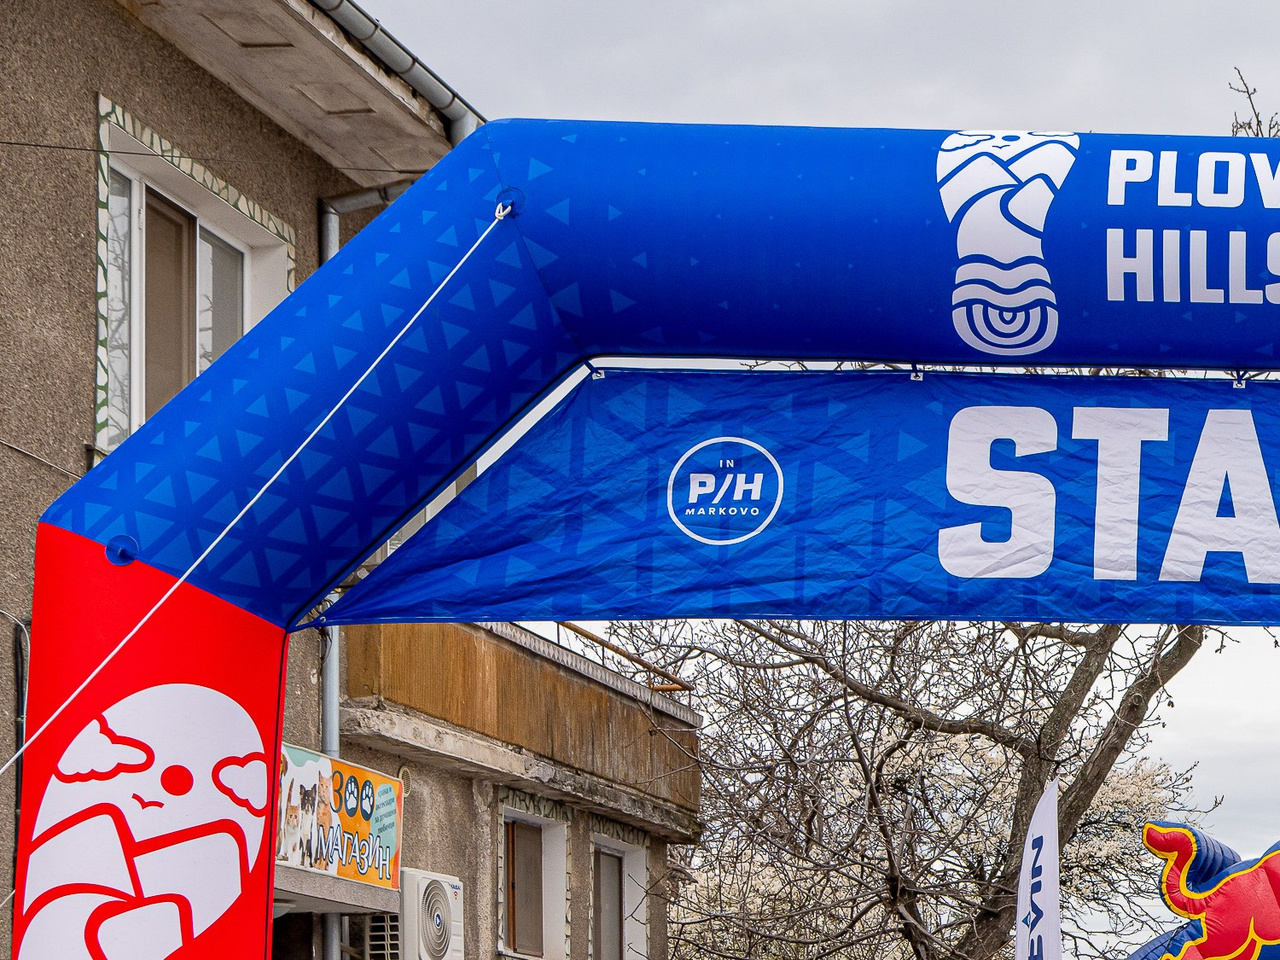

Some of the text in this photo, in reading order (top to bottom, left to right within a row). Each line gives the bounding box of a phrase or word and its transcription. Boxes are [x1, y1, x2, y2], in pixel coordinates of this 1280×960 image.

[719, 459, 735, 469] IN
[688, 473, 764, 504] P/H
[685, 507, 760, 516] MARKOVO
[317, 824, 391, 880] МАГАЗИН
